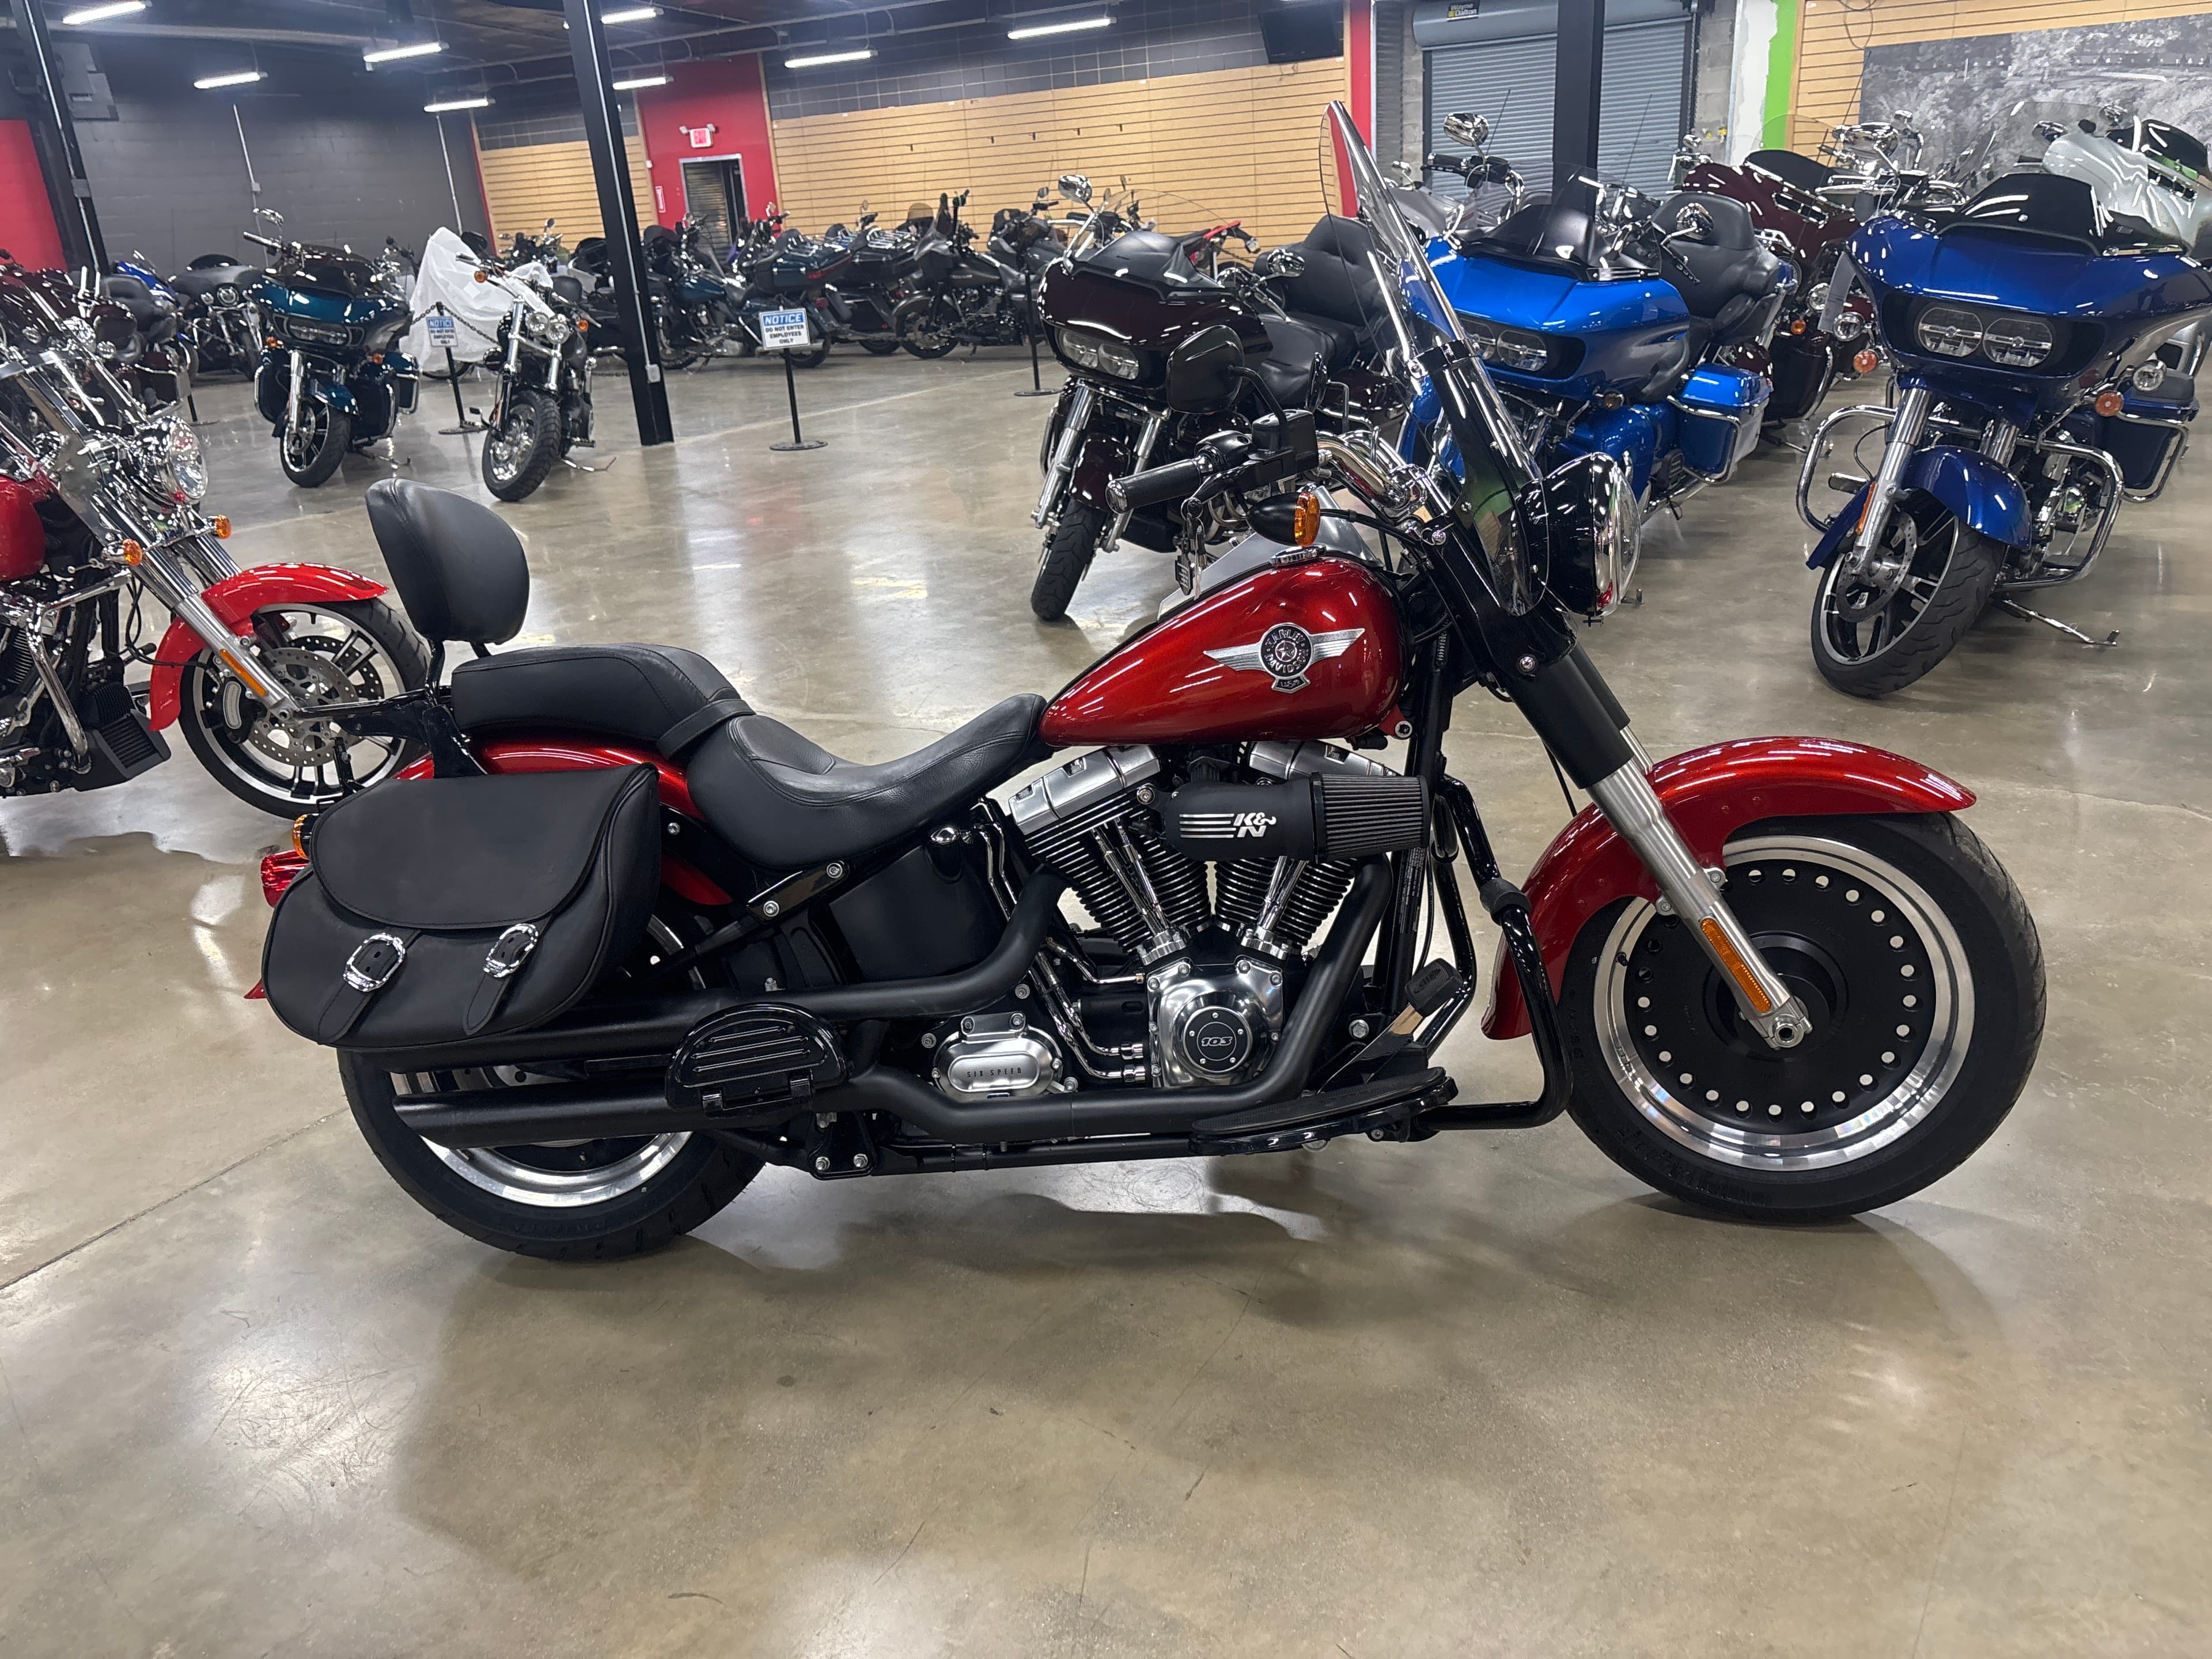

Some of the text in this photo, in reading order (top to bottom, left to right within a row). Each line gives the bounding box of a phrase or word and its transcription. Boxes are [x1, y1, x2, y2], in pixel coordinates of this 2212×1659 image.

[765, 313, 802, 325] NOTICE
[1201, 1036, 1234, 1047] 103
[990, 1067, 1022, 1076] SPEED
